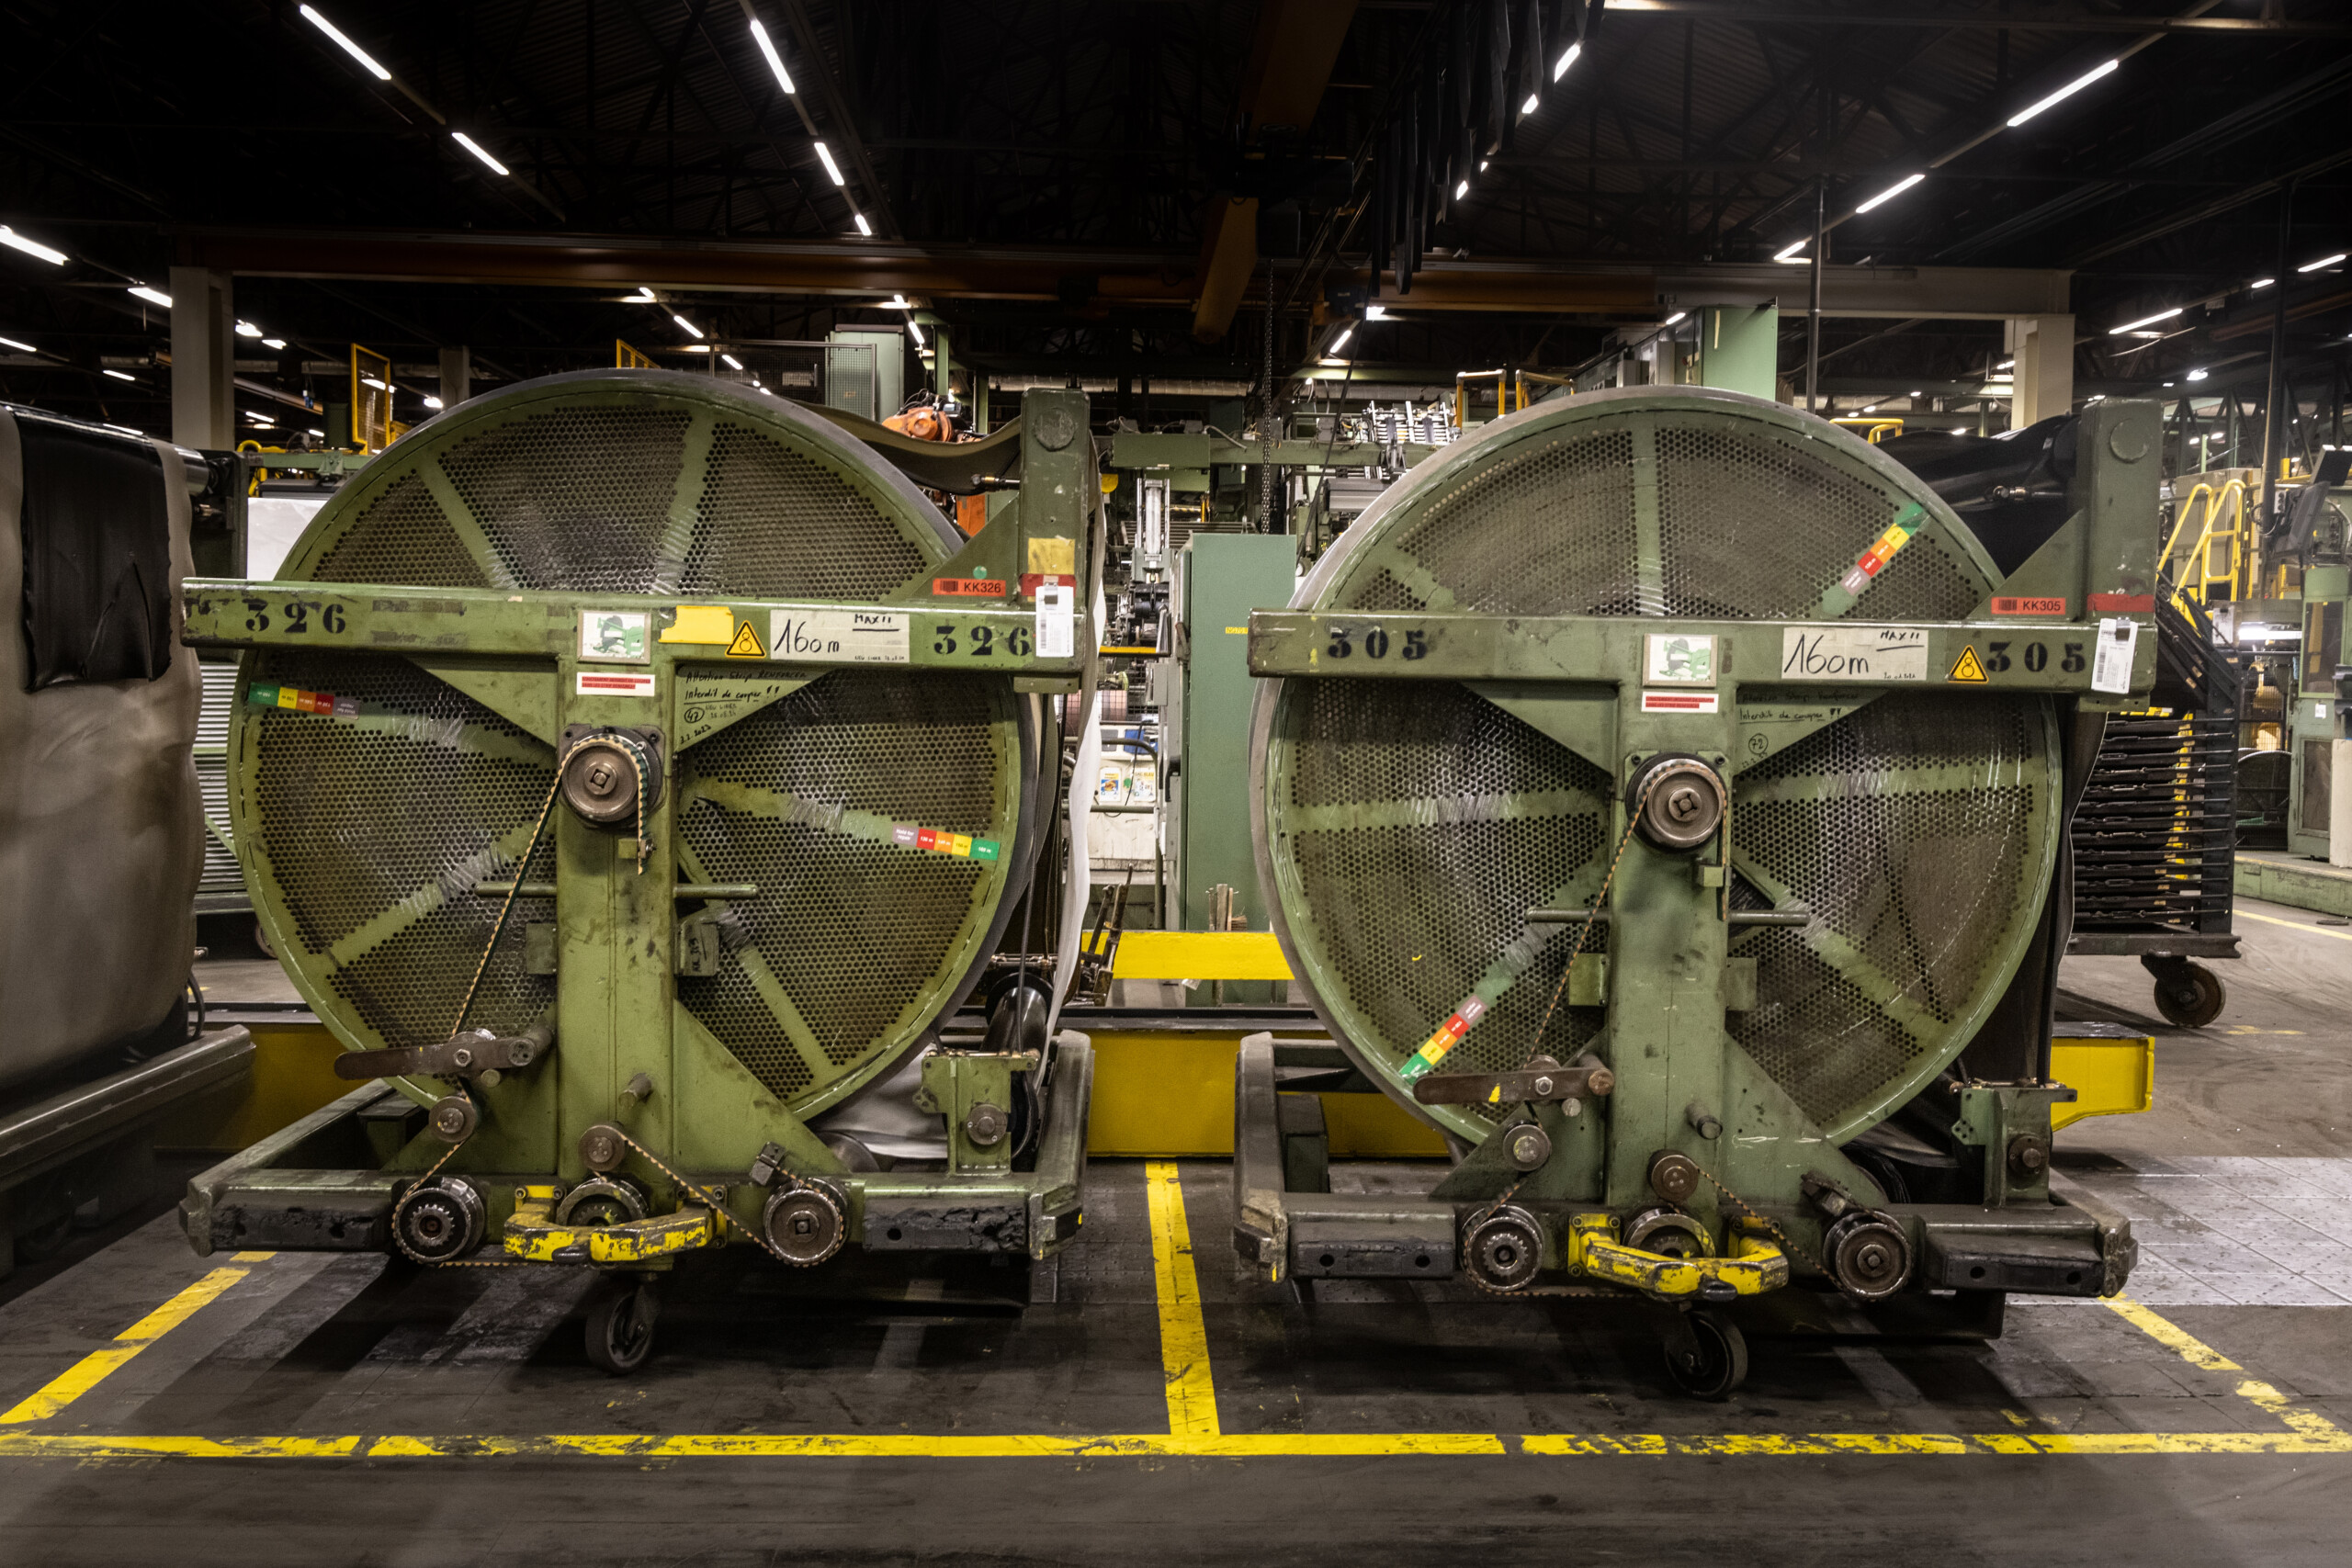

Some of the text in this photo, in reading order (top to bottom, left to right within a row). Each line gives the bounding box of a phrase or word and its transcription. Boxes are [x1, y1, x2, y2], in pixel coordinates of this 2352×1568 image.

[964, 582, 1001, 593] KK326
[245, 600, 345, 634] 326
[2022, 600, 2061, 611] KK305
[933, 626, 1030, 656] 326
[1328, 629, 1427, 660] 305
[1986, 641, 2086, 672] 305
[722, 688, 731, 698] de
